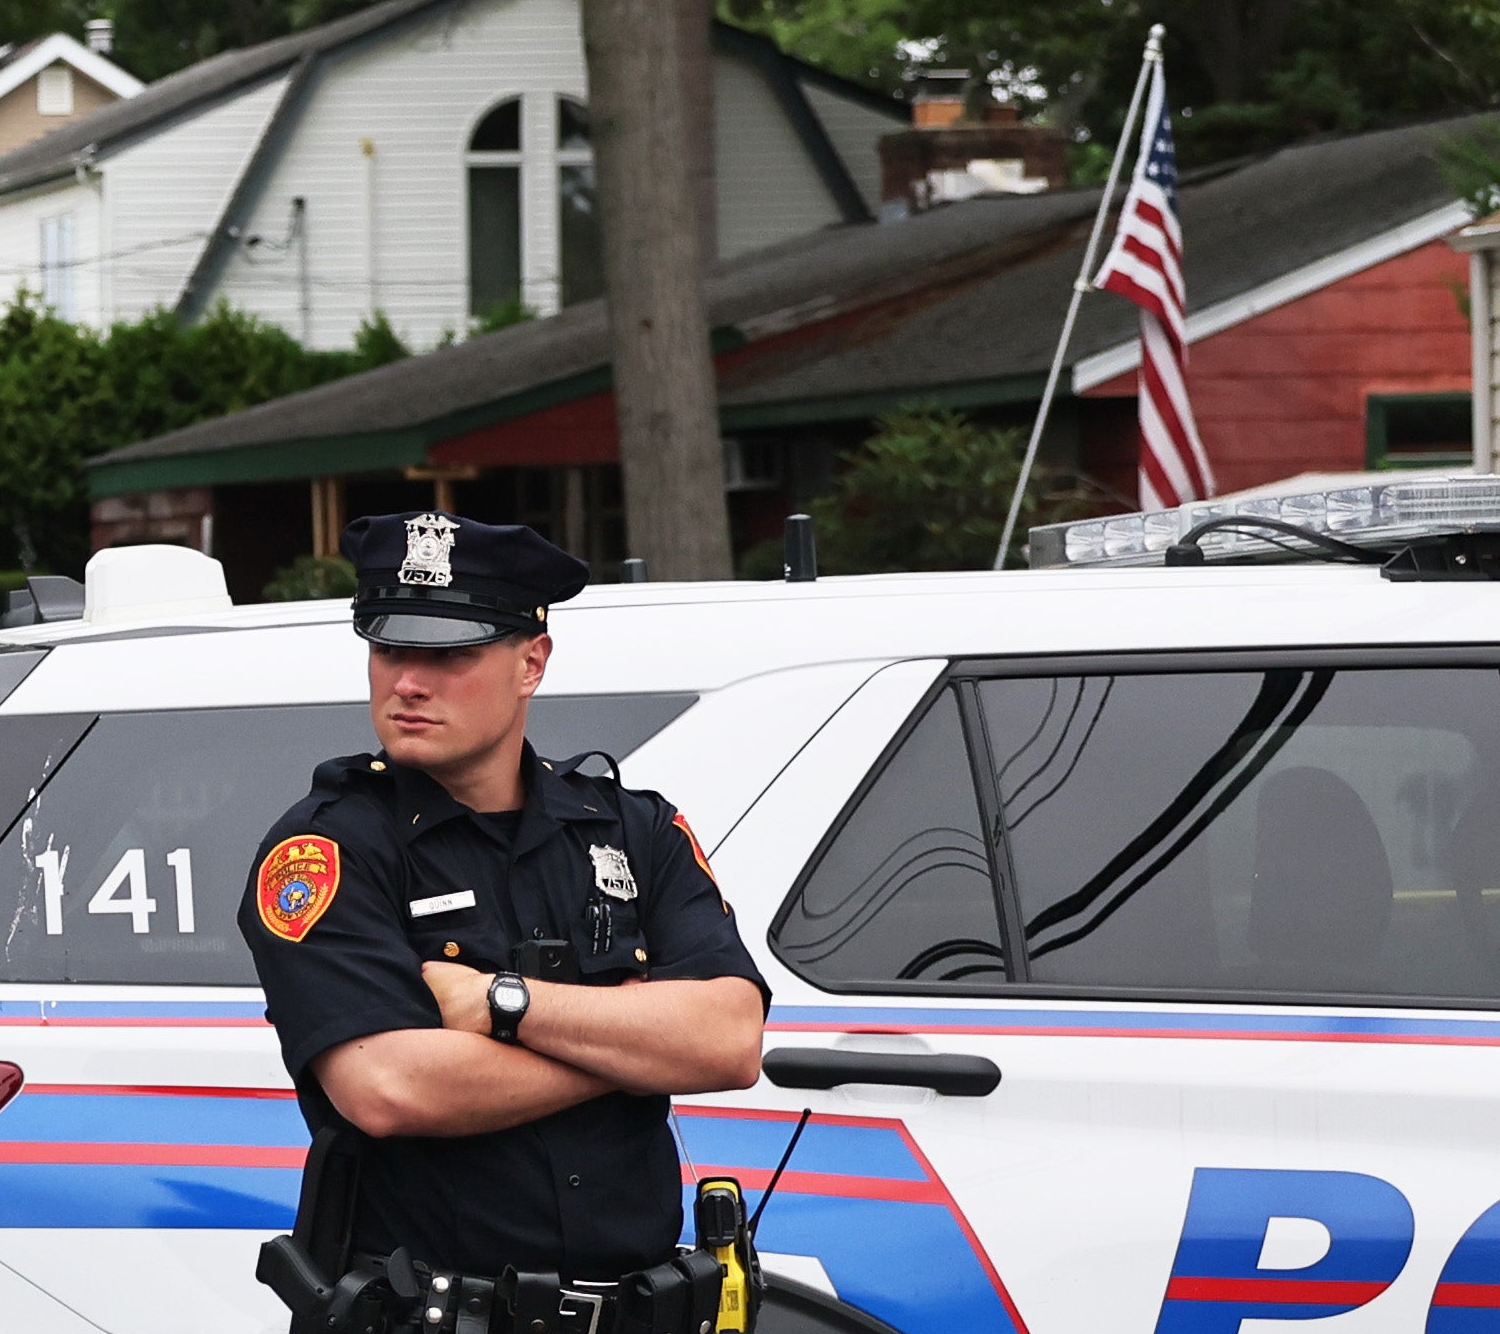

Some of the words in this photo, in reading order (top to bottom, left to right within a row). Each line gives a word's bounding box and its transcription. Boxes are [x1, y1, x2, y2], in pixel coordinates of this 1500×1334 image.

[276, 863, 310, 880] POLICE
[35, 848, 195, 935] 141
[429, 898, 453, 910] QUINN
